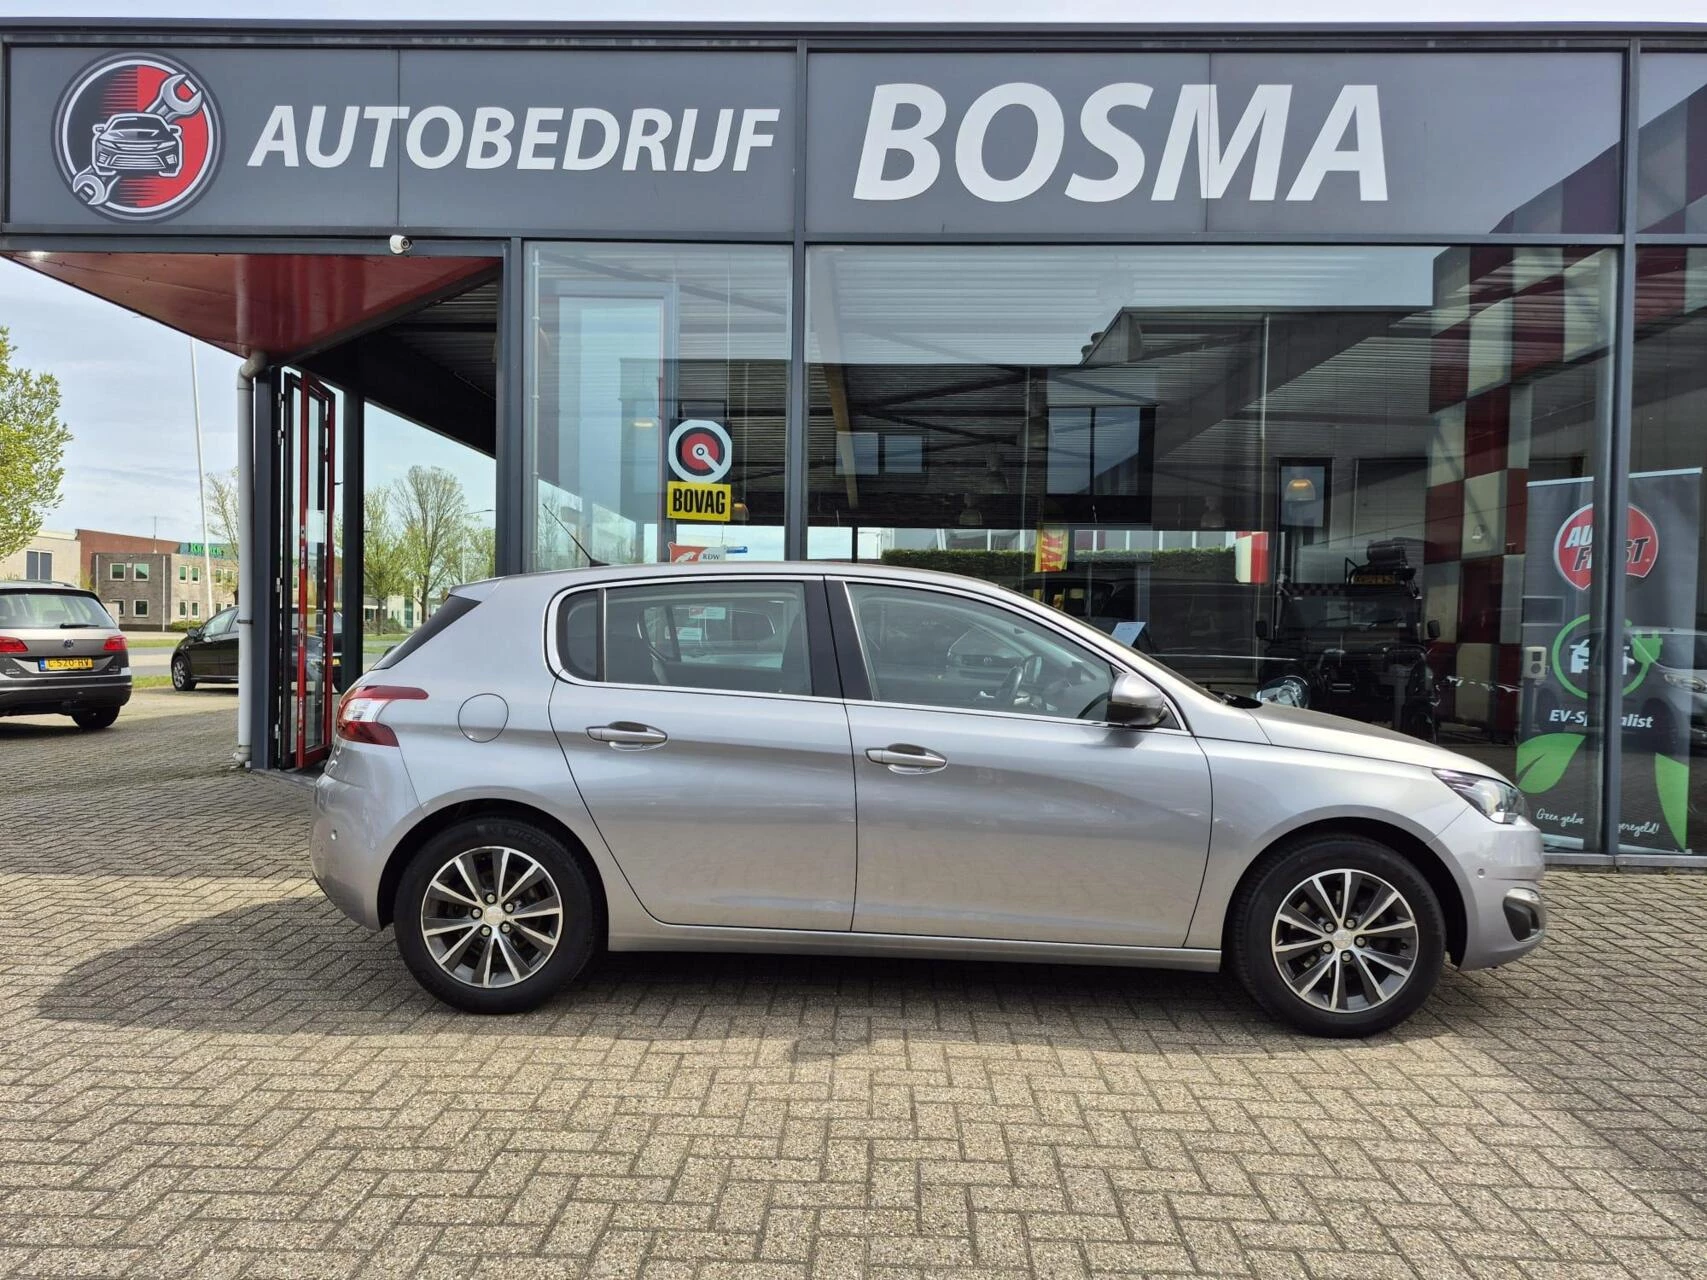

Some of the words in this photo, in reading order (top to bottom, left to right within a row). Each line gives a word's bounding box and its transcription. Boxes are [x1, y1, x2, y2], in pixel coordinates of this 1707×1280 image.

[248, 105, 781, 173] AUTOBEDRIJF
[853, 82, 1389, 204] BOSMA
[672, 488, 726, 515] BOVAG
